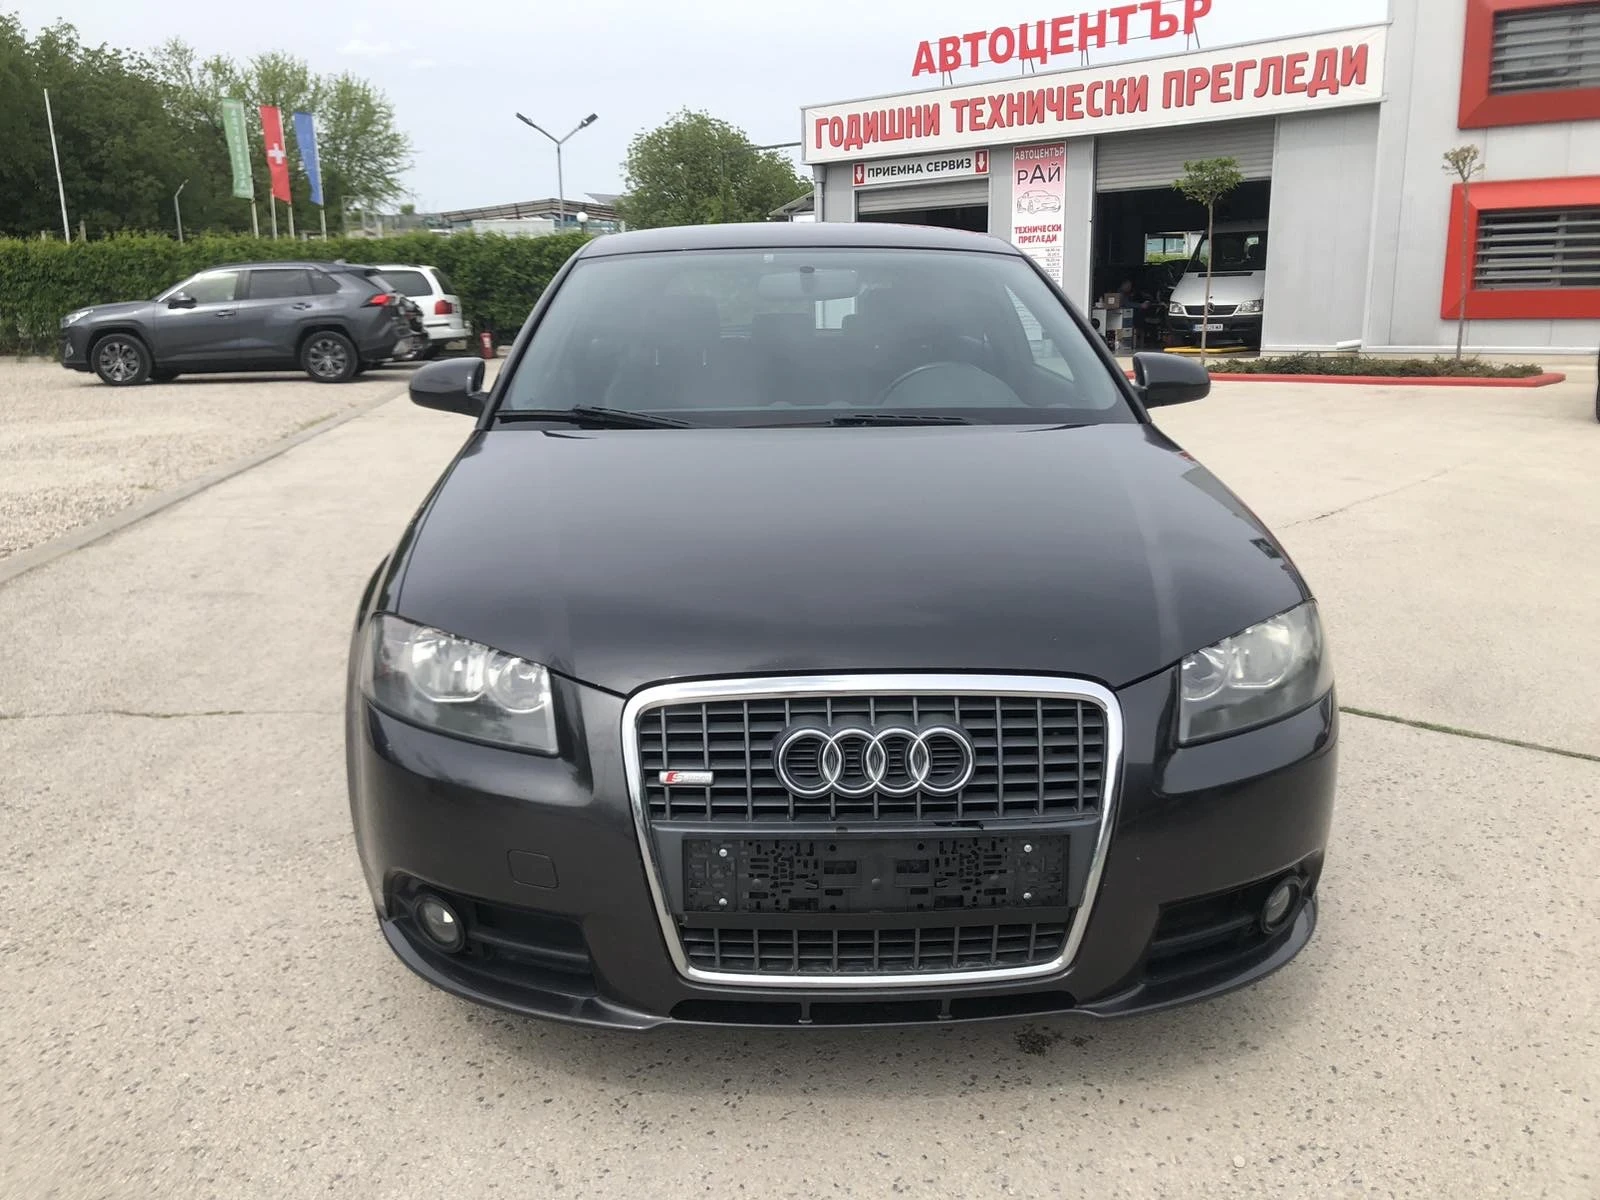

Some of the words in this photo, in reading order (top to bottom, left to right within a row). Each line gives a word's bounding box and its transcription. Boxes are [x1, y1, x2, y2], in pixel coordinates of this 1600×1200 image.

[912, 0, 1212, 77] АВТОЦЕНТЪР
[814, 102, 941, 152] ГОДИШНИ
[950, 74, 1149, 133] ТЕХНИЧЕСКИ
[1162, 43, 1369, 109] ПРЕГЛЕДИ
[1015, 146, 1065, 161] АВТОЦЕНТЪР
[867, 163, 924, 178] ПРИЕМНА
[926, 157, 972, 173] СЕРВИЗ
[1017, 162, 1061, 185] РАЙ
[1014, 223, 1062, 234] ТЕХНИЧЕСКИ
[1018, 233, 1057, 244] ПРЕГЛЕДИ
